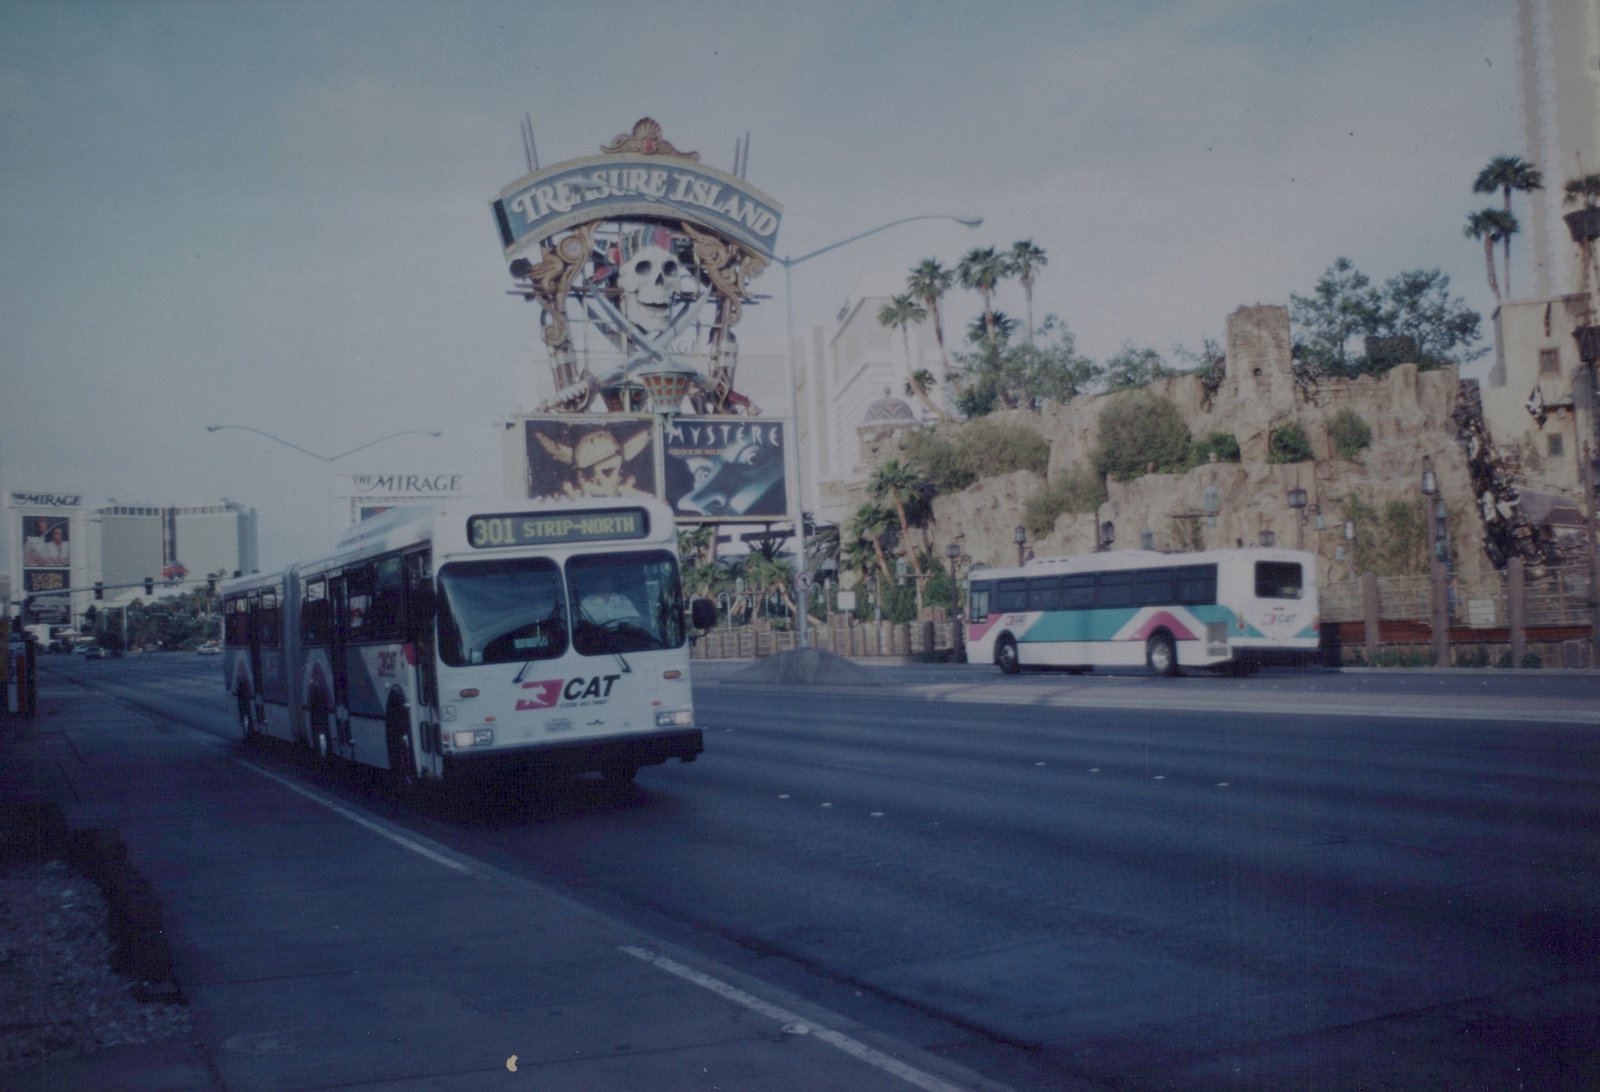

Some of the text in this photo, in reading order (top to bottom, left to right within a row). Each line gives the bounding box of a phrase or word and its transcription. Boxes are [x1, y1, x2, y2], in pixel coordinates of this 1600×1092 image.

[670, 172, 779, 236] ISLAND
[668, 423, 780, 447] MYSTÈRE
[352, 474, 462, 492] THE MIRAGE
[19, 494, 82, 507] MIRAGE
[473, 516, 635, 545] 301 STRIP-NORTH
[564, 674, 621, 701] CAT
